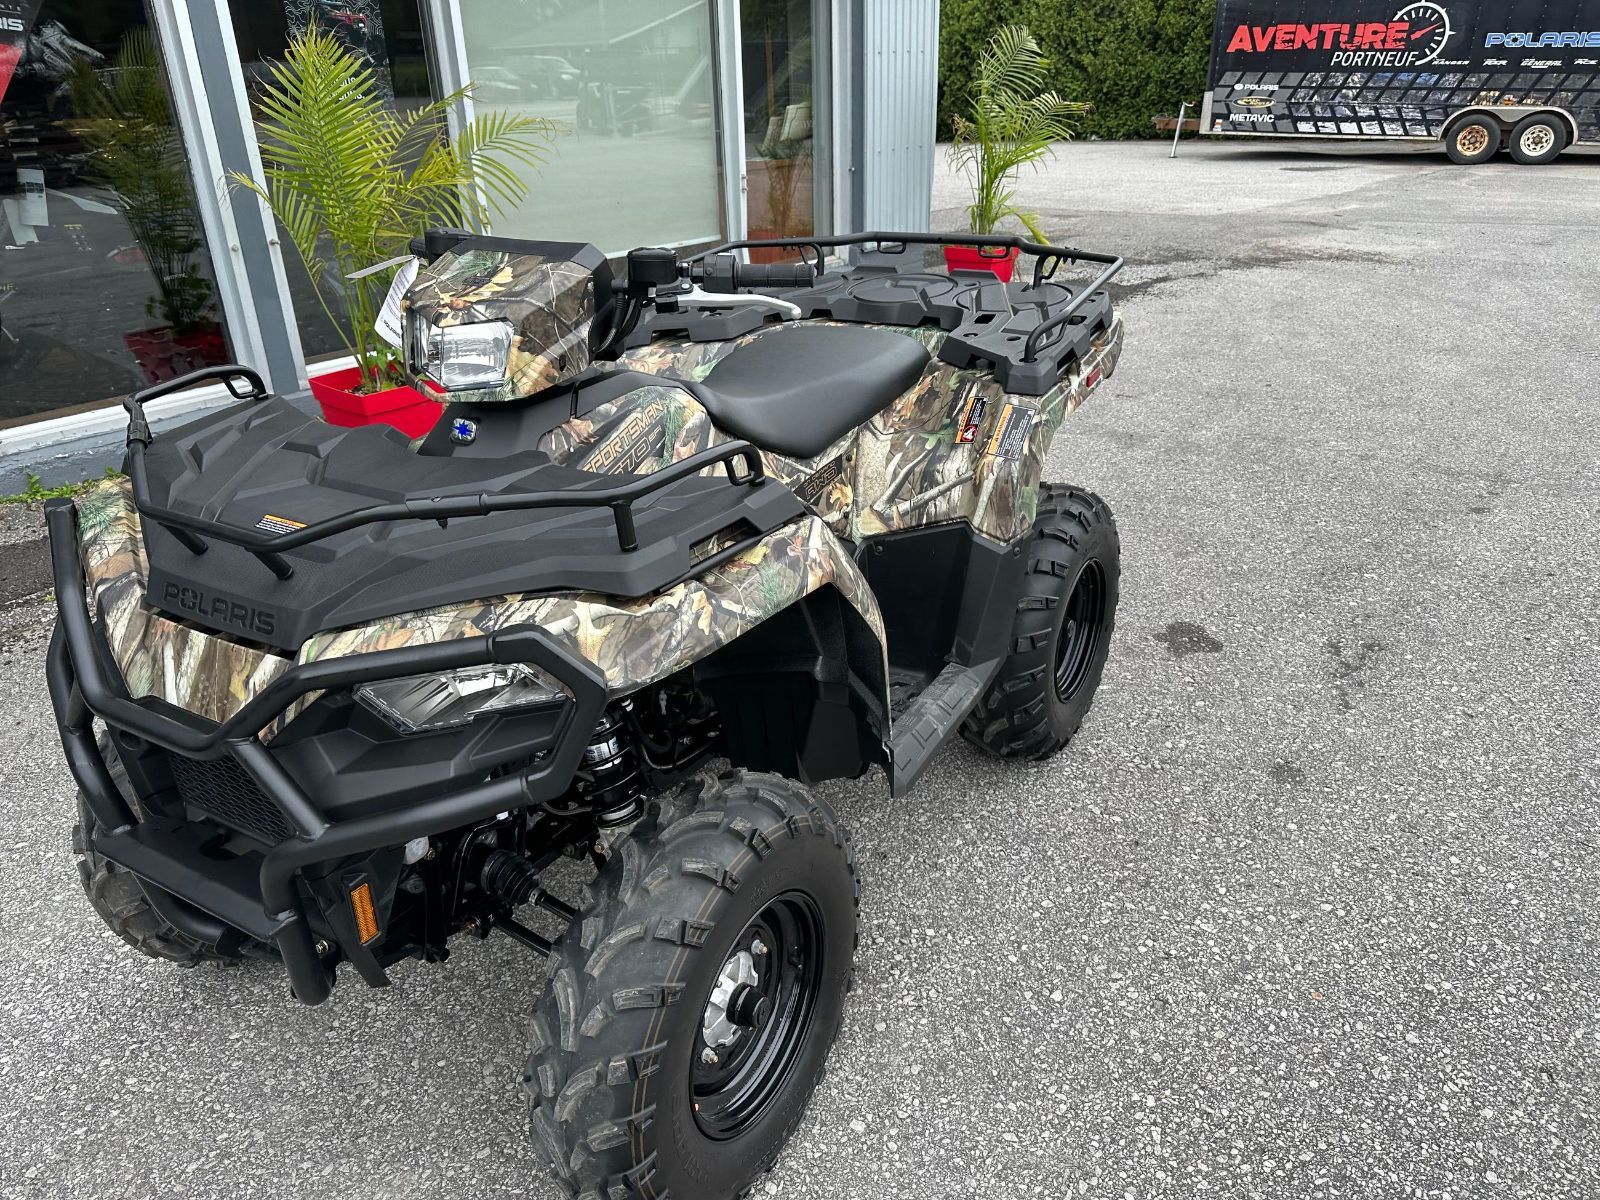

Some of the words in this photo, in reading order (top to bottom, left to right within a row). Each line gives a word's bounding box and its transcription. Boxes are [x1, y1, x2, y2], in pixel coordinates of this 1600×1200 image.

[0, 17, 23, 31] IS
[1226, 22, 1409, 52] AVENTURE
[1484, 31, 1600, 48] POLARIS
[1330, 51, 1419, 67] PORTNEUF
[1229, 113, 1275, 122] METAVIC
[805, 466, 838, 500] AWD
[163, 581, 276, 636] POLARIS
